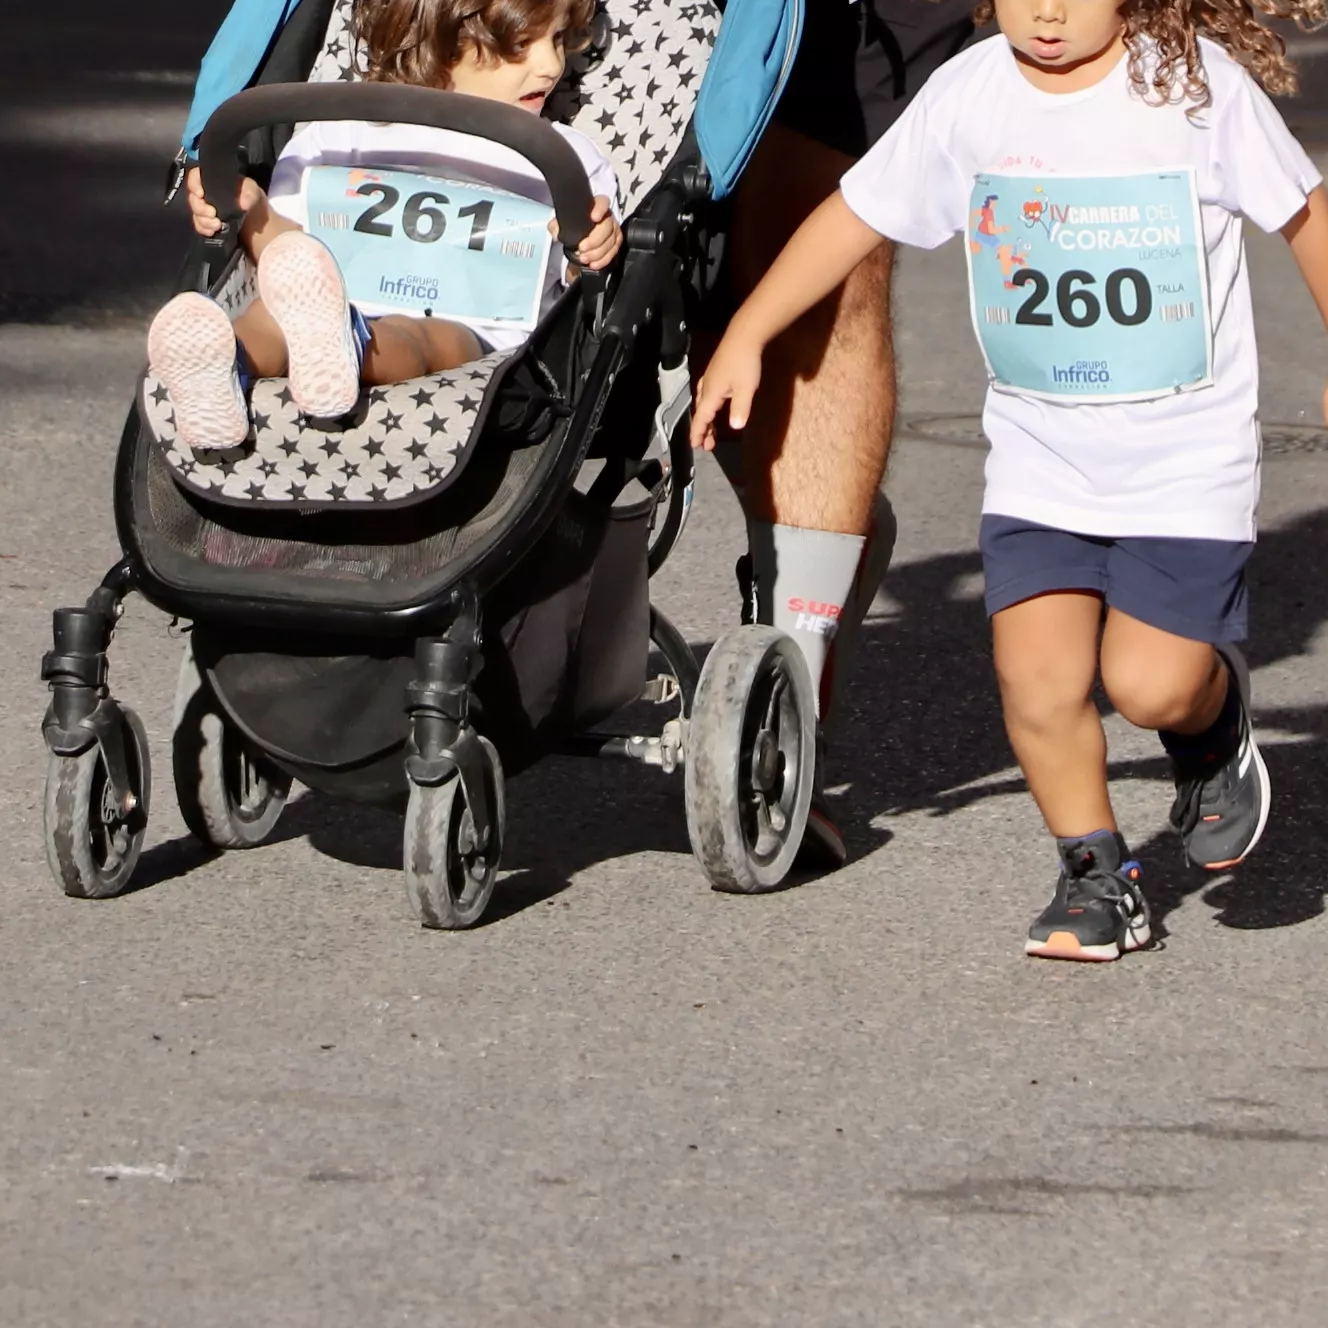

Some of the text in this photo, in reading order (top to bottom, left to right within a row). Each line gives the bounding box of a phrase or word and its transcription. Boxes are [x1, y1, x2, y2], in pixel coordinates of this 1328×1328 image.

[353, 183, 494, 252] 261
[1050, 204, 1070, 223] IV
[1145, 204, 1178, 221] DEL
[1058, 221, 1181, 250] CORAZÓN
[1138, 248, 1181, 260] LUCENA
[379, 275, 439, 300] Infrico
[406, 275, 439, 287] GRUPO
[1157, 283, 1184, 293] TALLA
[1012, 268, 1152, 328] 260
[1053, 365, 1110, 383] Infrico
[1076, 361, 1107, 370] GRUPO
